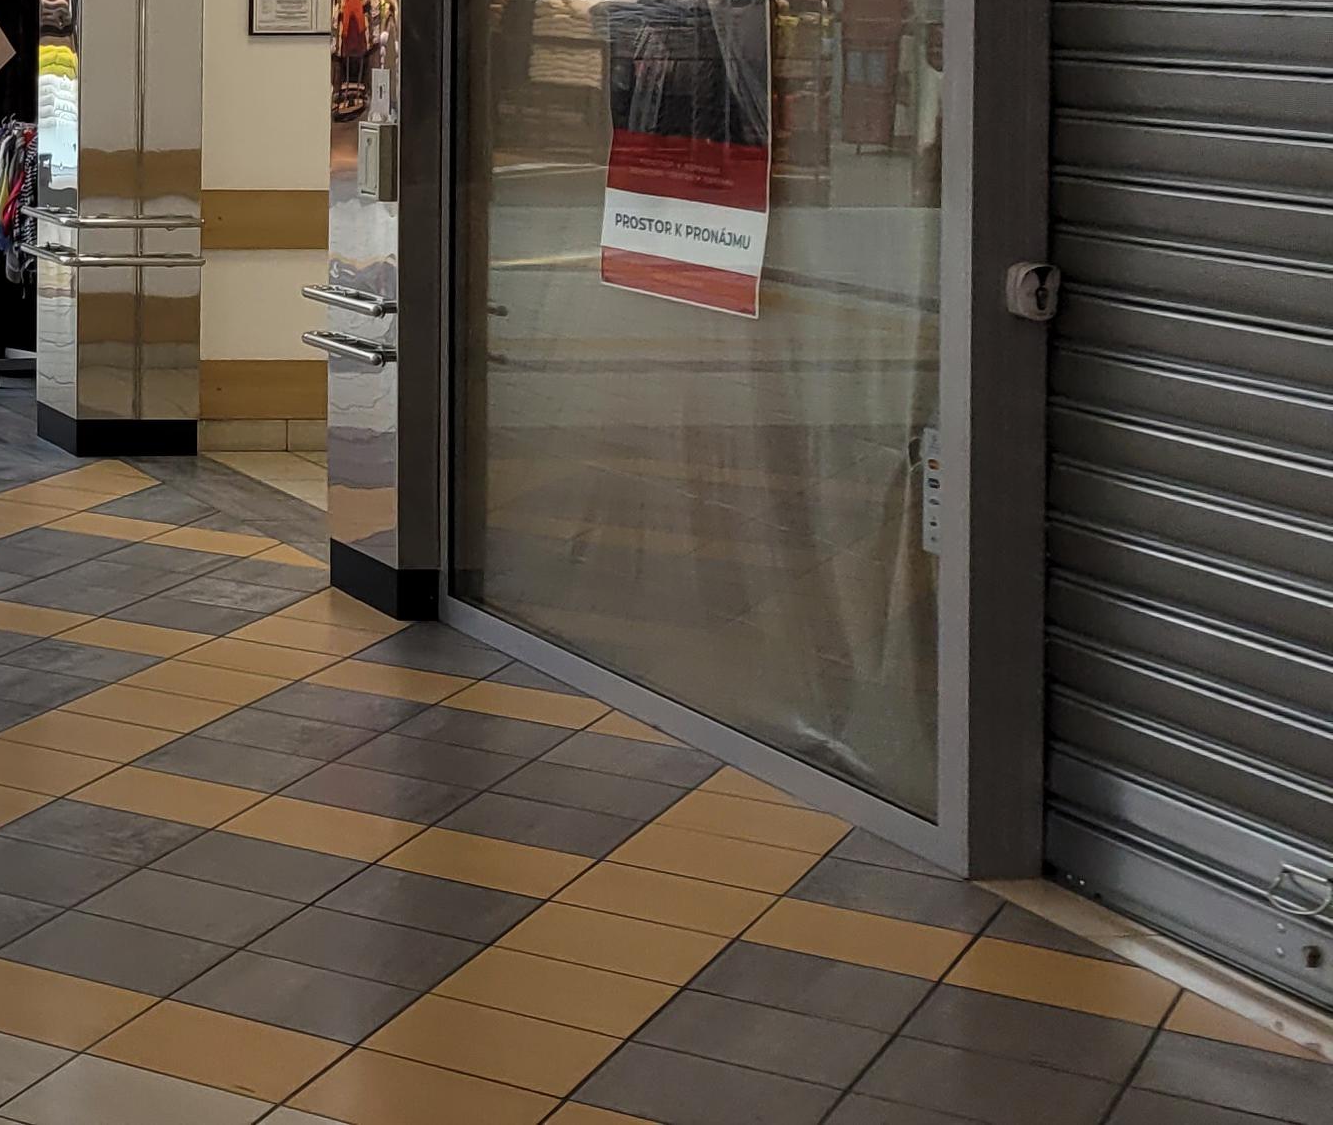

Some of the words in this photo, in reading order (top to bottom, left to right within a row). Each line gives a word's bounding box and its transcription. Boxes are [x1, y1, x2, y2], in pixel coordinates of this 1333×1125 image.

[615, 212, 672, 236] PROSTOR
[674, 223, 683, 238] K
[685, 224, 751, 250] PRONÁJMU
